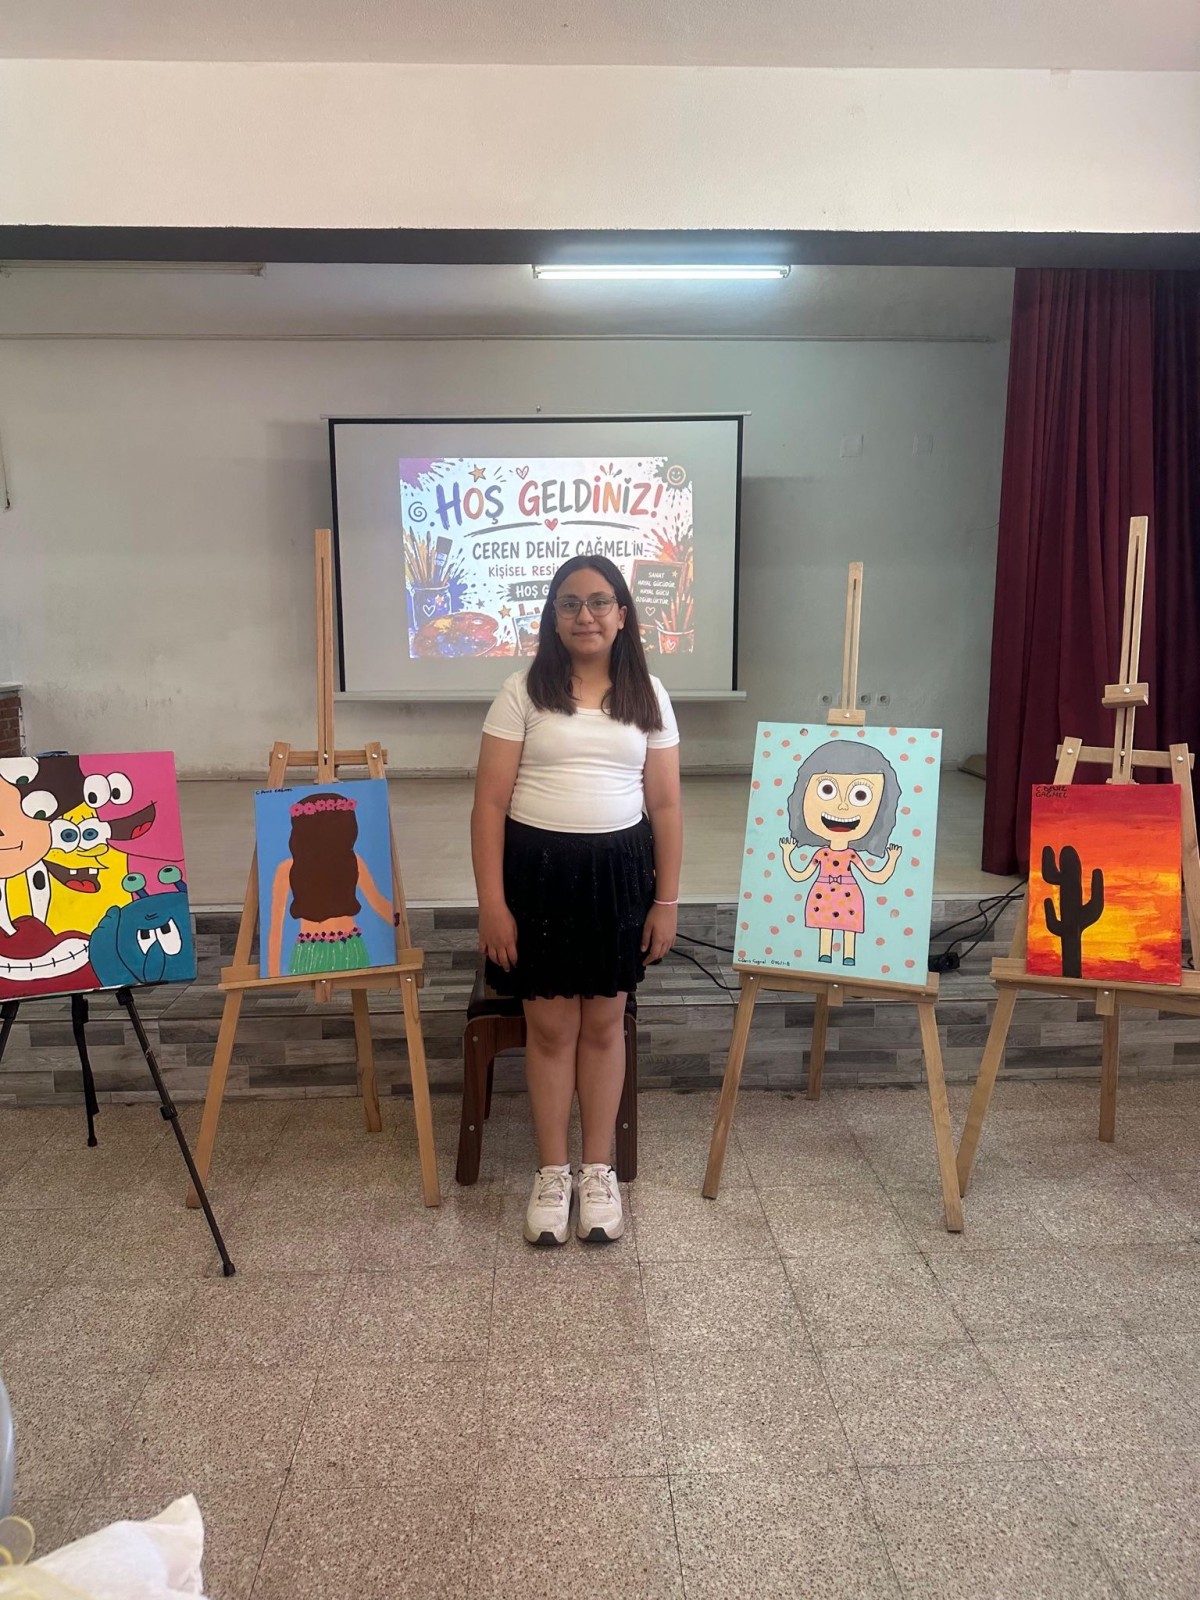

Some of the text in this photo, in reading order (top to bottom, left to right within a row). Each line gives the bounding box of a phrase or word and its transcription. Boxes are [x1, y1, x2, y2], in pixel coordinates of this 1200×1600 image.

[435, 475, 664, 531] HOŞ GELDİNİZ!
[472, 541, 520, 560] CEREN
[526, 536, 570, 559] DENİZ
[488, 563, 559, 579] KİŞİSEL RESİ
[515, 585, 538, 599] HOŞ
